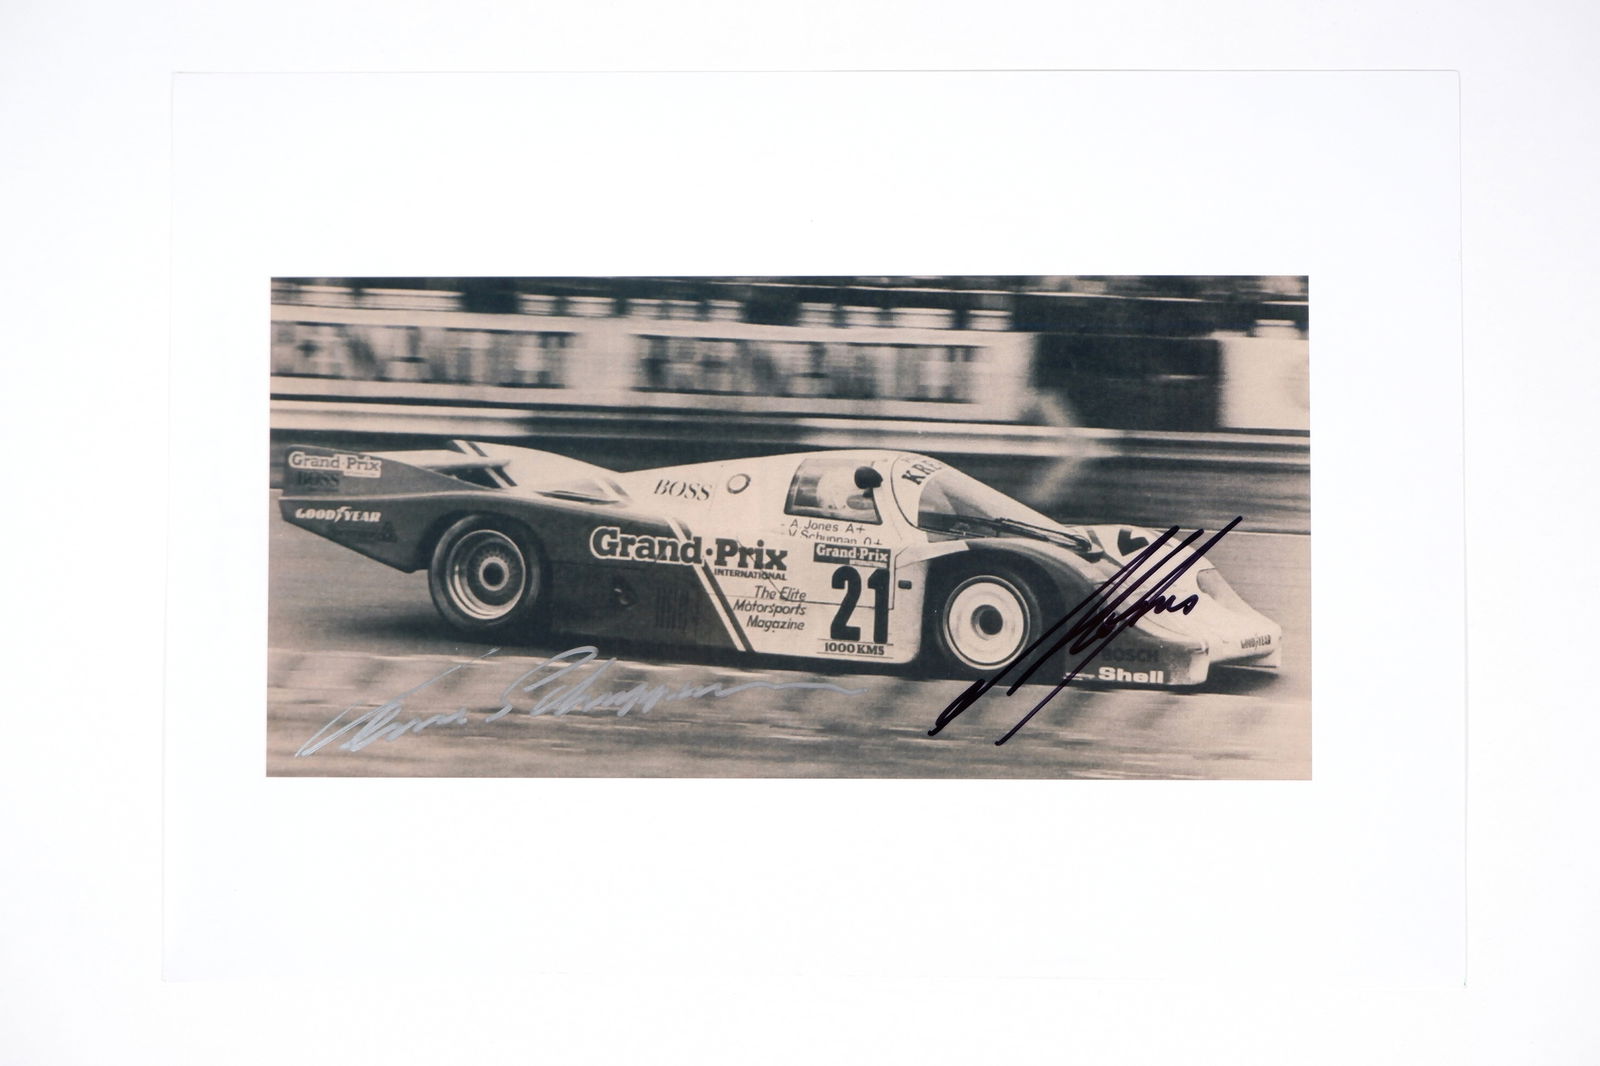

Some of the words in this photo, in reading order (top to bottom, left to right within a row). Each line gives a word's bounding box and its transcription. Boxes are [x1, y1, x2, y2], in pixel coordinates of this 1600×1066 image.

[654, 479, 713, 501] BOSS
[790, 519, 799, 528] A
[803, 520, 839, 532] Jones
[845, 523, 866, 534] A+
[714, 567, 788, 581] INTERNATIONAL
[754, 585, 777, 600] The
[780, 586, 807, 601] Elite
[733, 599, 807, 617] Motorsports
[831, 566, 890, 645] 21
[746, 614, 805, 632] Magazine
[824, 642, 855, 653] 1000
[857, 643, 885, 656] KMS
[1098, 666, 1165, 685] Shell
